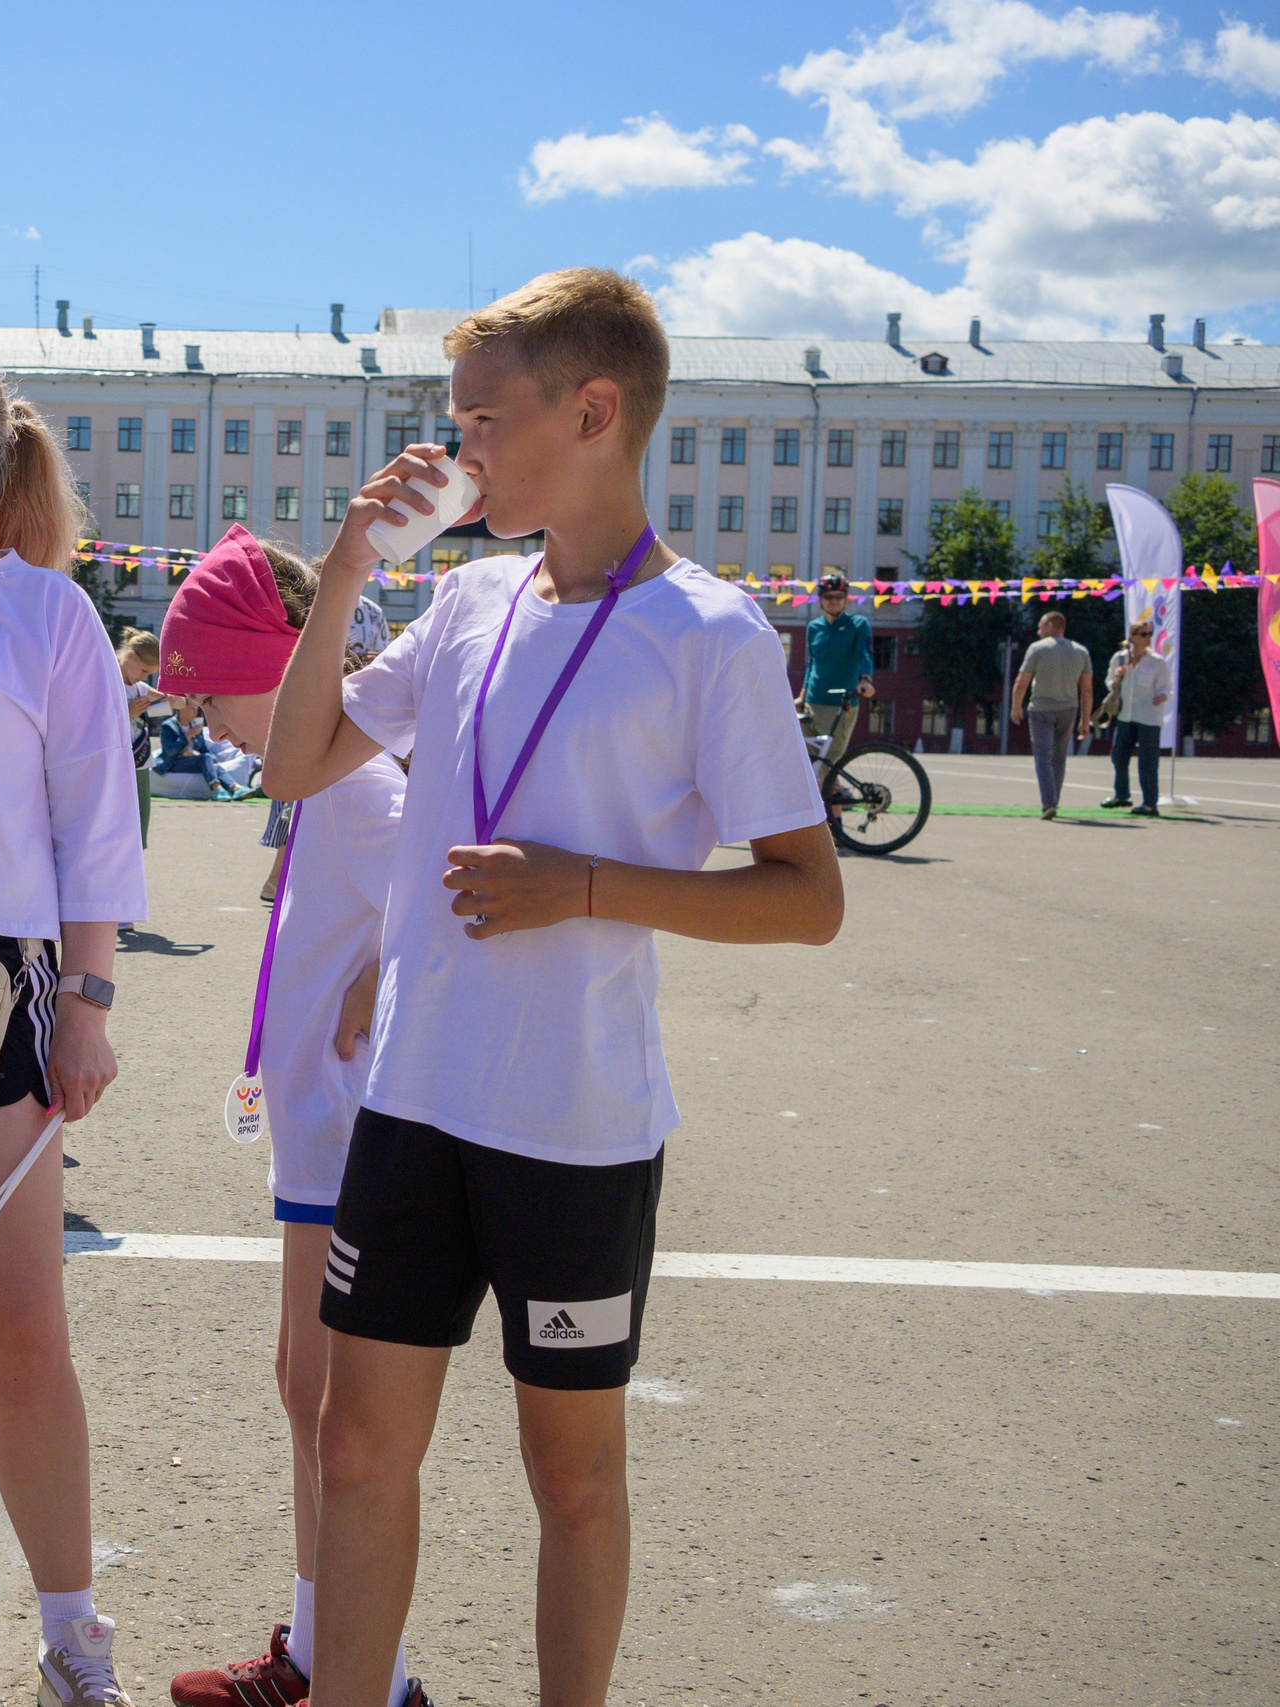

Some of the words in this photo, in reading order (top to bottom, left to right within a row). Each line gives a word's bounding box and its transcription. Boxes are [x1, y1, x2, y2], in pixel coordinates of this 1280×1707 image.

[238, 1113, 260, 1125] ЖИВИ
[237, 1124, 259, 1135] ЯРКО!
[539, 1328, 585, 1339] adidas
